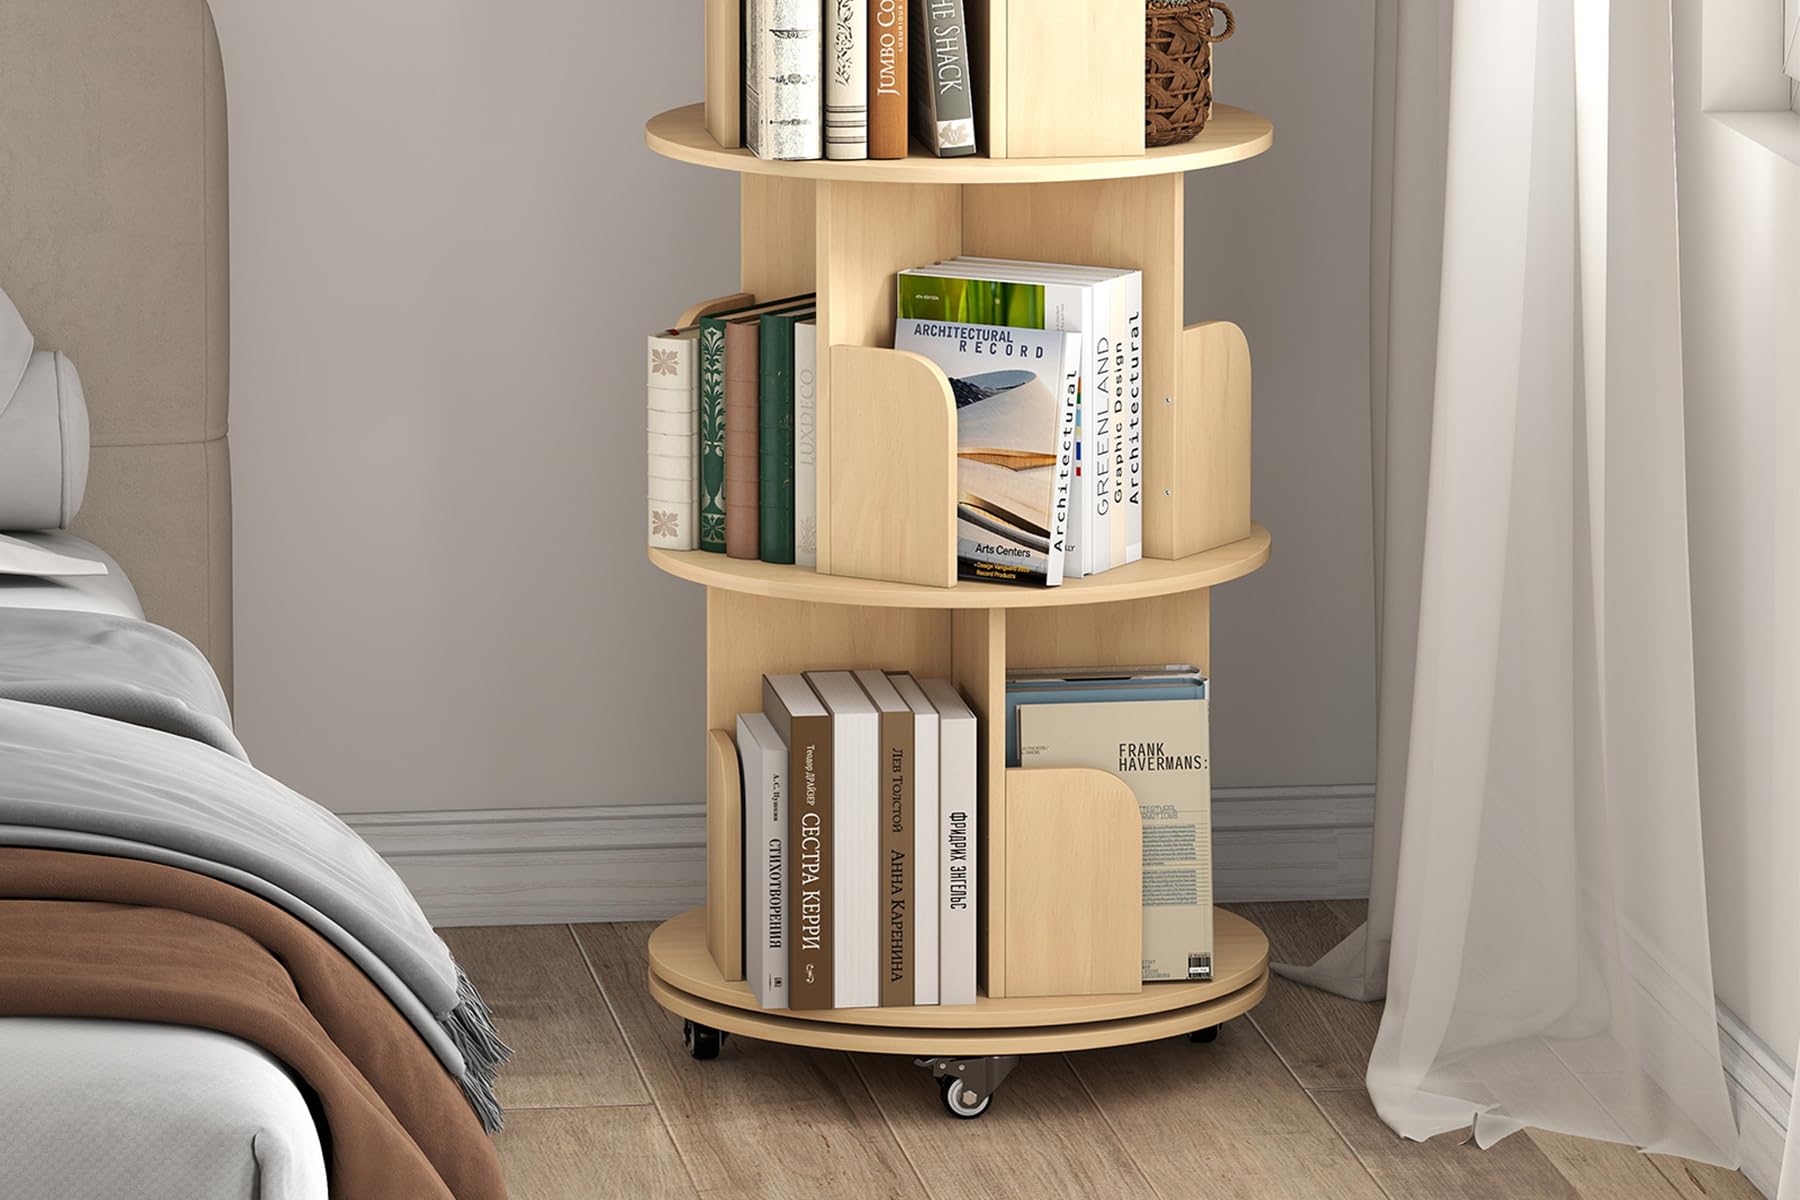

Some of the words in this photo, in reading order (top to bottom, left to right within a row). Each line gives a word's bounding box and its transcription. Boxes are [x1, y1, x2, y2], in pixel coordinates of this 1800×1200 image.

[877, 32, 900, 97] JUMBO
[934, 25, 963, 96] SHACK
[914, 323, 1014, 343] ARCHITECTURAL
[959, 339, 1044, 359] RECORD
[1114, 341, 1124, 414] Design
[1129, 311, 1140, 505] Architectural
[800, 368, 814, 466] LUXDECO
[1097, 336, 1110, 516] GREENLAND
[1053, 370, 1077, 553] Architectural
[1114, 422, 1125, 504] Graphic
[975, 543, 995, 555] Arts
[996, 544, 1032, 558] Centers
[1119, 742, 1165, 758] FRANK
[1119, 755, 1208, 772] HAVERMANS:
[802, 812, 821, 886] СЕСТРА
[949, 811, 968, 862] ФРИДРИХ
[769, 838, 782, 949] СТИХОТВОРЕНИЯ
[802, 890, 821, 950] КЕРРИ
[949, 865, 967, 910] ЭНГЕЛЬС
